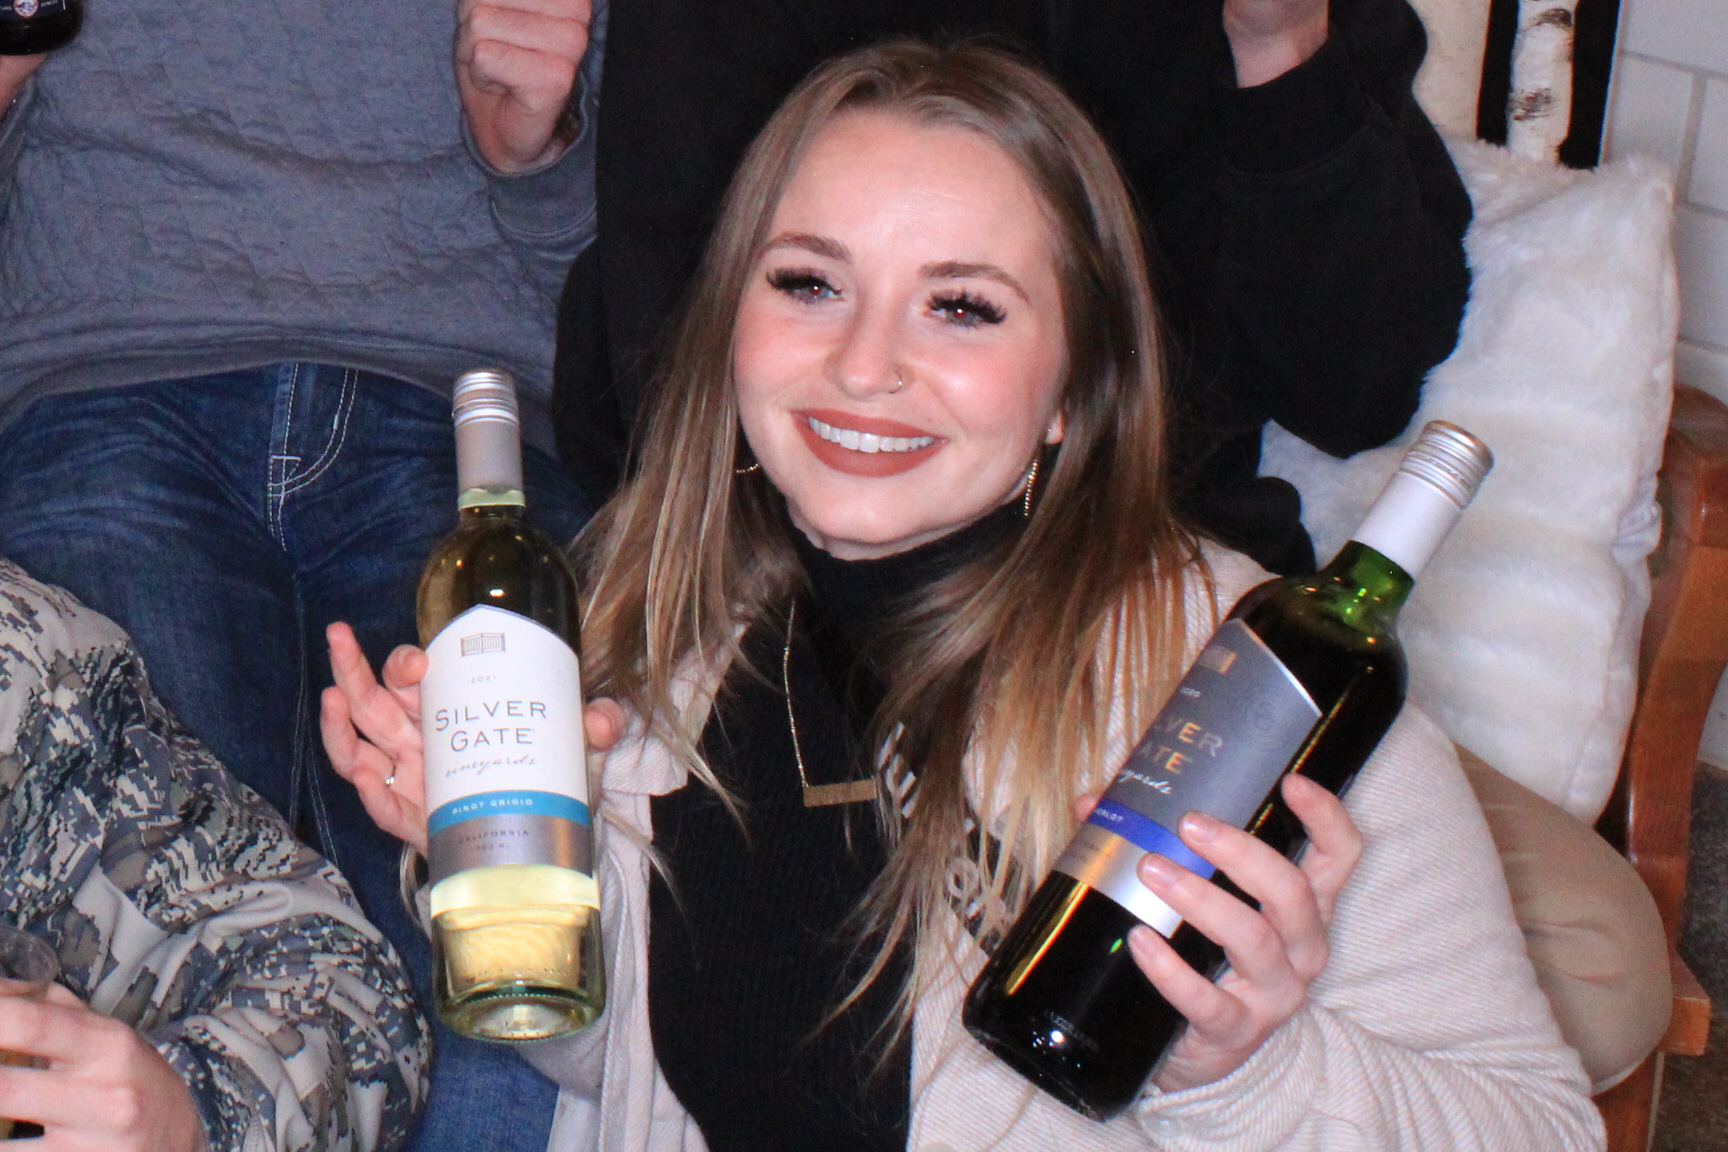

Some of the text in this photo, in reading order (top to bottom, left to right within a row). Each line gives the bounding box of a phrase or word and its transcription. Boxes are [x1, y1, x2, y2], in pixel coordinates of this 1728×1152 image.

[470, 675, 496, 684] 2021
[435, 700, 547, 732] SILVER
[450, 727, 533, 753] GATE
[445, 754, 538, 778] vineyards
[452, 798, 535, 815] PINOT GRIGIO
